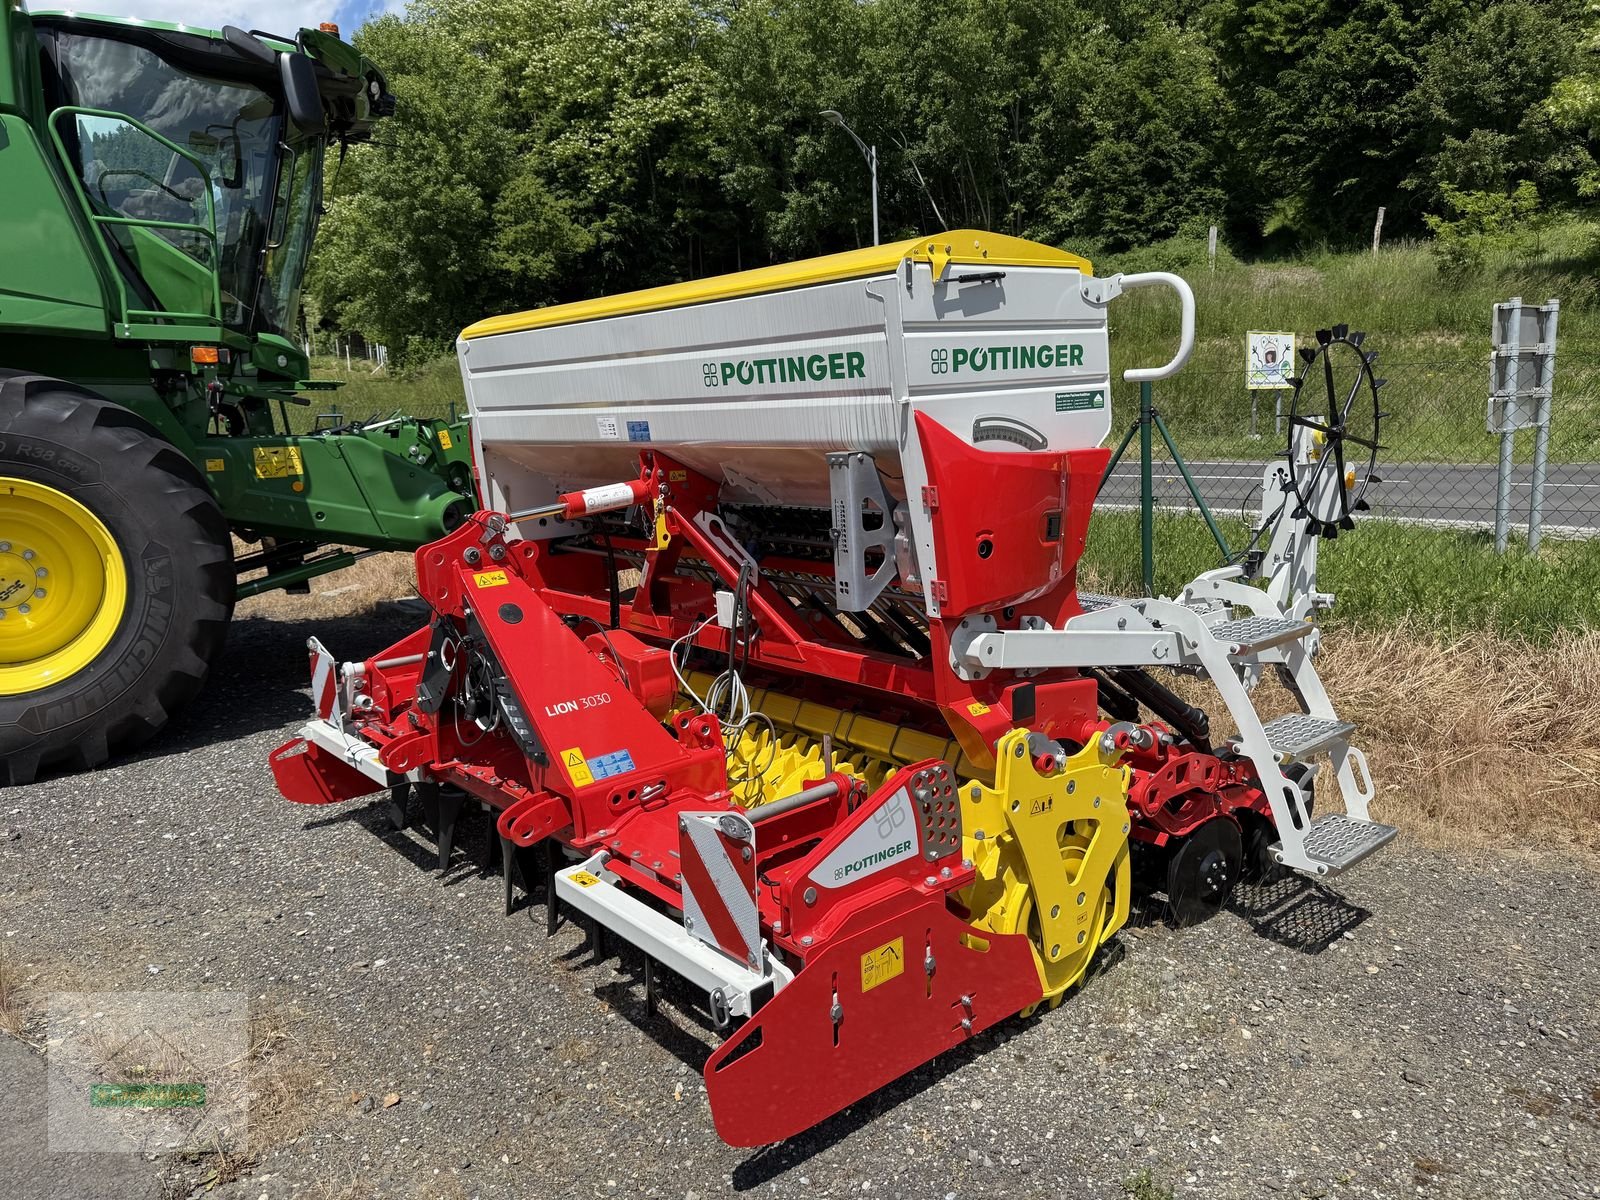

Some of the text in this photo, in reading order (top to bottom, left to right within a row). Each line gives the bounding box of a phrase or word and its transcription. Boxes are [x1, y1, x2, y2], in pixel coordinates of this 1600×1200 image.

[720, 351, 866, 386] PÖTTINGER
[952, 344, 1084, 373] PÖTTINGER
[16, 443, 56, 461] R38
[45, 597, 172, 730] MICHELIN
[544, 692, 611, 717] LION 3030
[844, 840, 911, 876] PÖTTINGER
